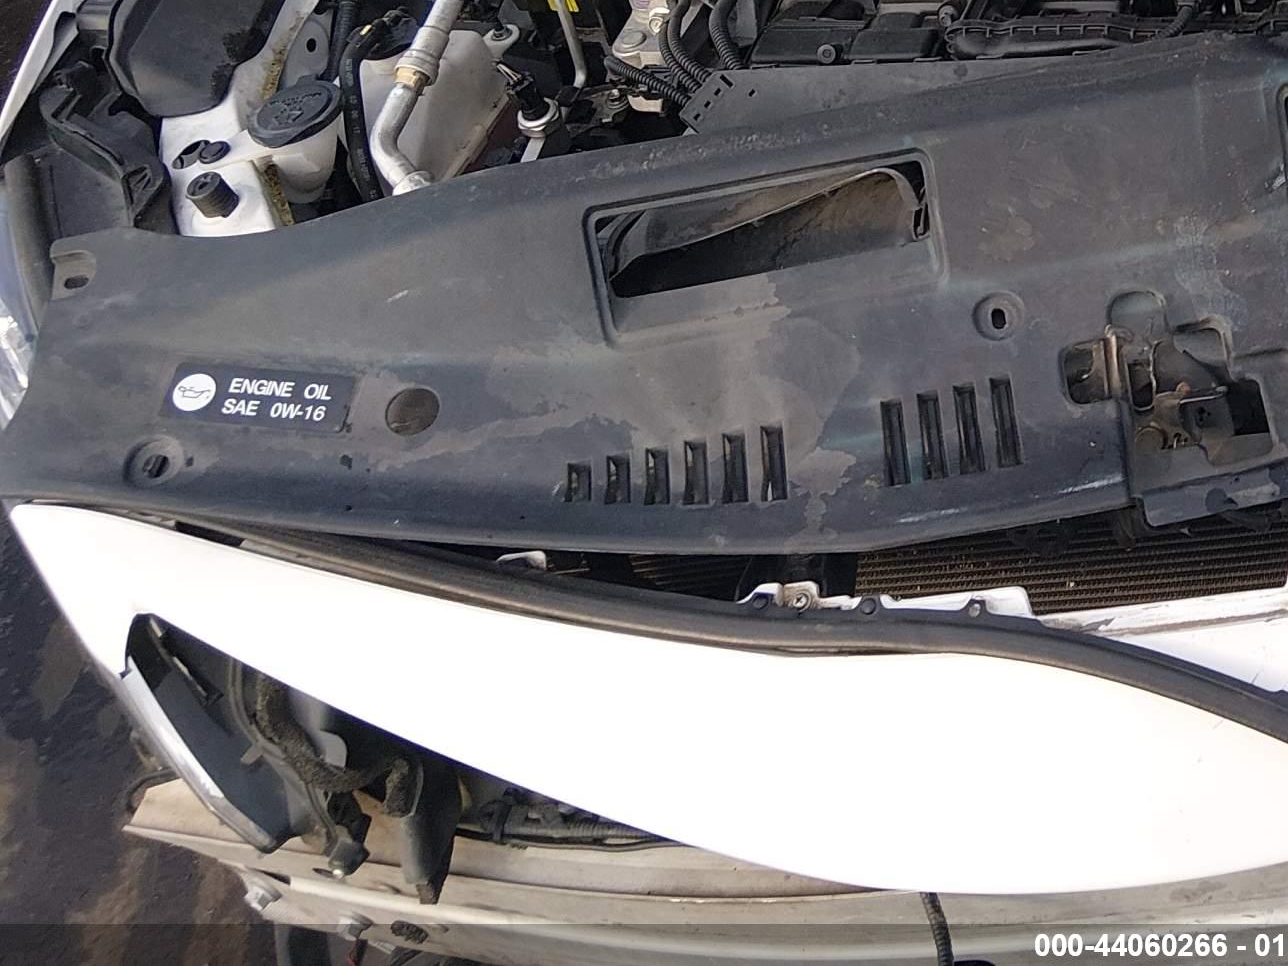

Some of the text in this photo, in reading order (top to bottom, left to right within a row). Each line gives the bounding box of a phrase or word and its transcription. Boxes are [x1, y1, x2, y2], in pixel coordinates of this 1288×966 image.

[228, 378, 332, 401] ENGINE OIL
[221, 398, 327, 422] SAE 0W-16
